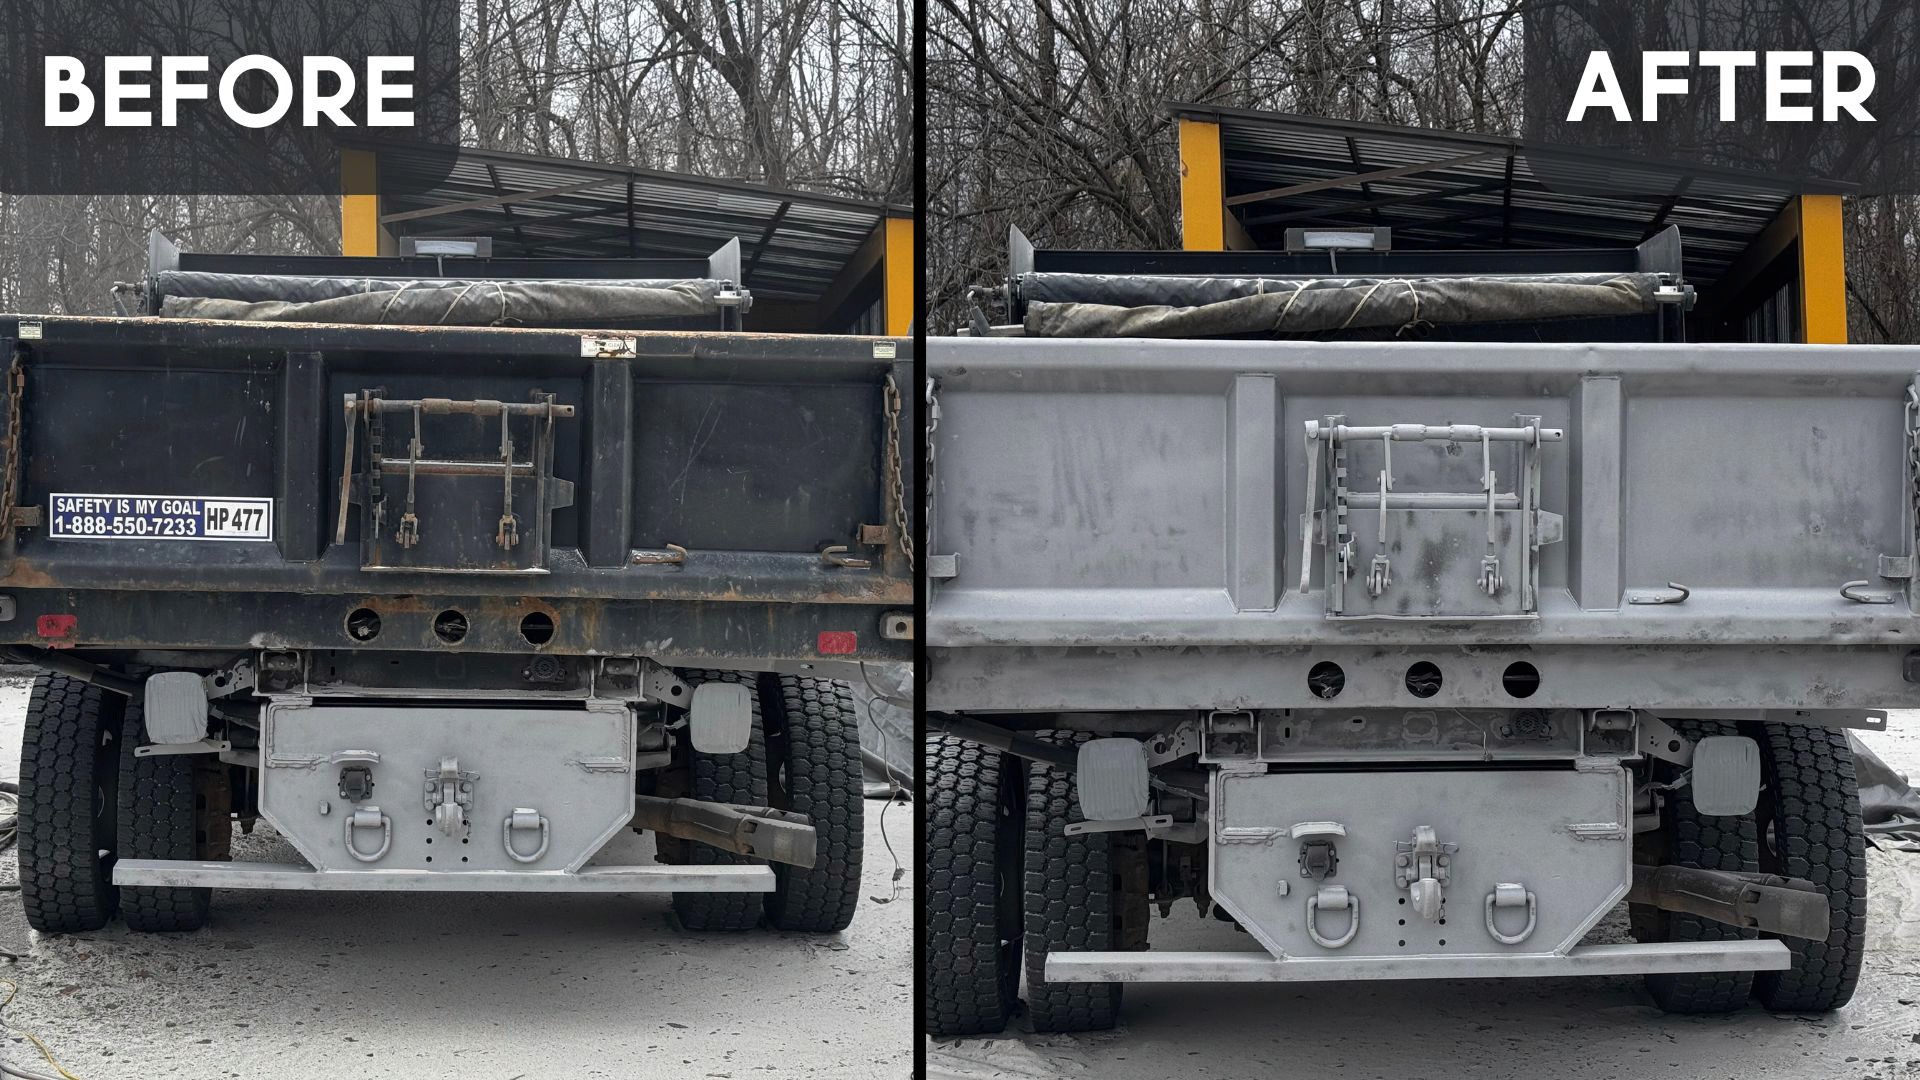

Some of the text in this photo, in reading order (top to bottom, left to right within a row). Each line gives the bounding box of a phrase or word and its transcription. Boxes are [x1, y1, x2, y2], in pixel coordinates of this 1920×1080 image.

[57, 498, 201, 516] SAFETY IS MY GOAL
[55, 515, 197, 536] 1-888-550-7233
[206, 507, 264, 532] HP 477
